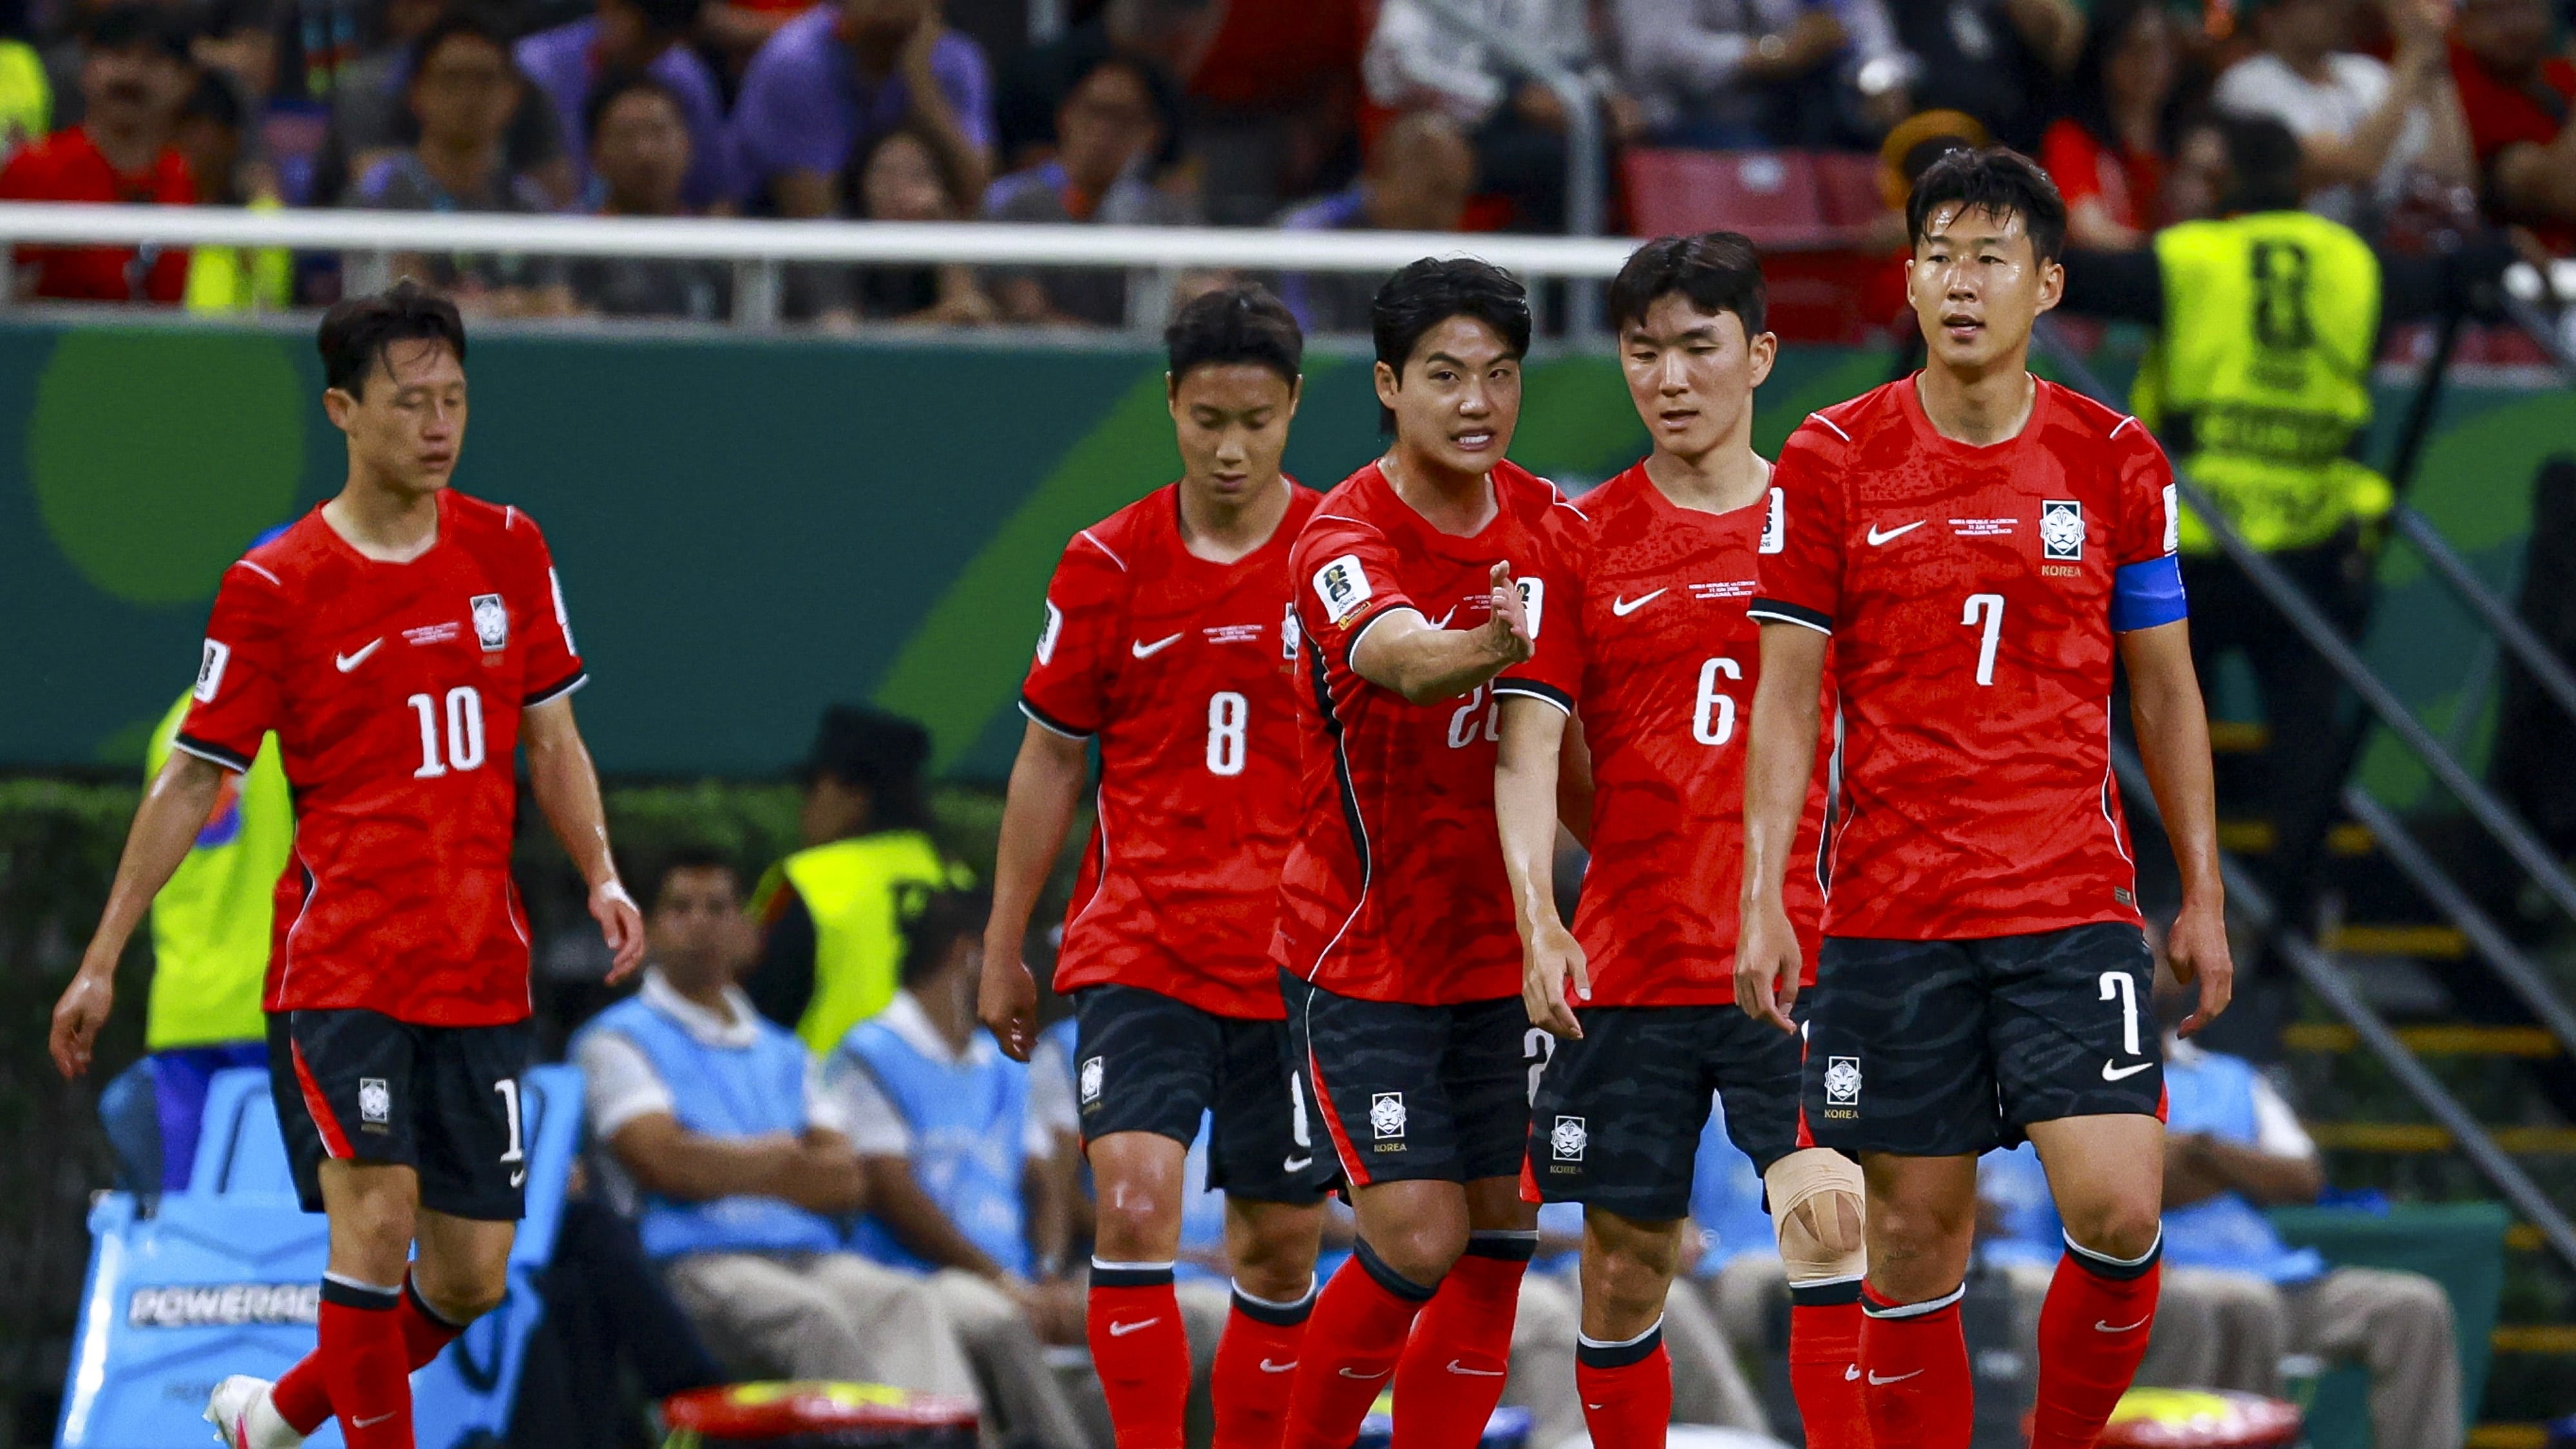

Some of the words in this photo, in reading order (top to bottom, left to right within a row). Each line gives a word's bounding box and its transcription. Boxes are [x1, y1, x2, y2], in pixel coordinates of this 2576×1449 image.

[2041, 565, 2081, 577] KOREA
[1960, 594, 2004, 686] 7
[407, 686, 484, 778] 10
[1206, 691, 1247, 776] 8
[1692, 657, 1743, 745] 6
[2098, 971, 2142, 1056] 7
[494, 1078, 523, 1162] 1
[1373, 1142, 1407, 1153] KOREA
[1824, 1108, 1859, 1119] KOREA
